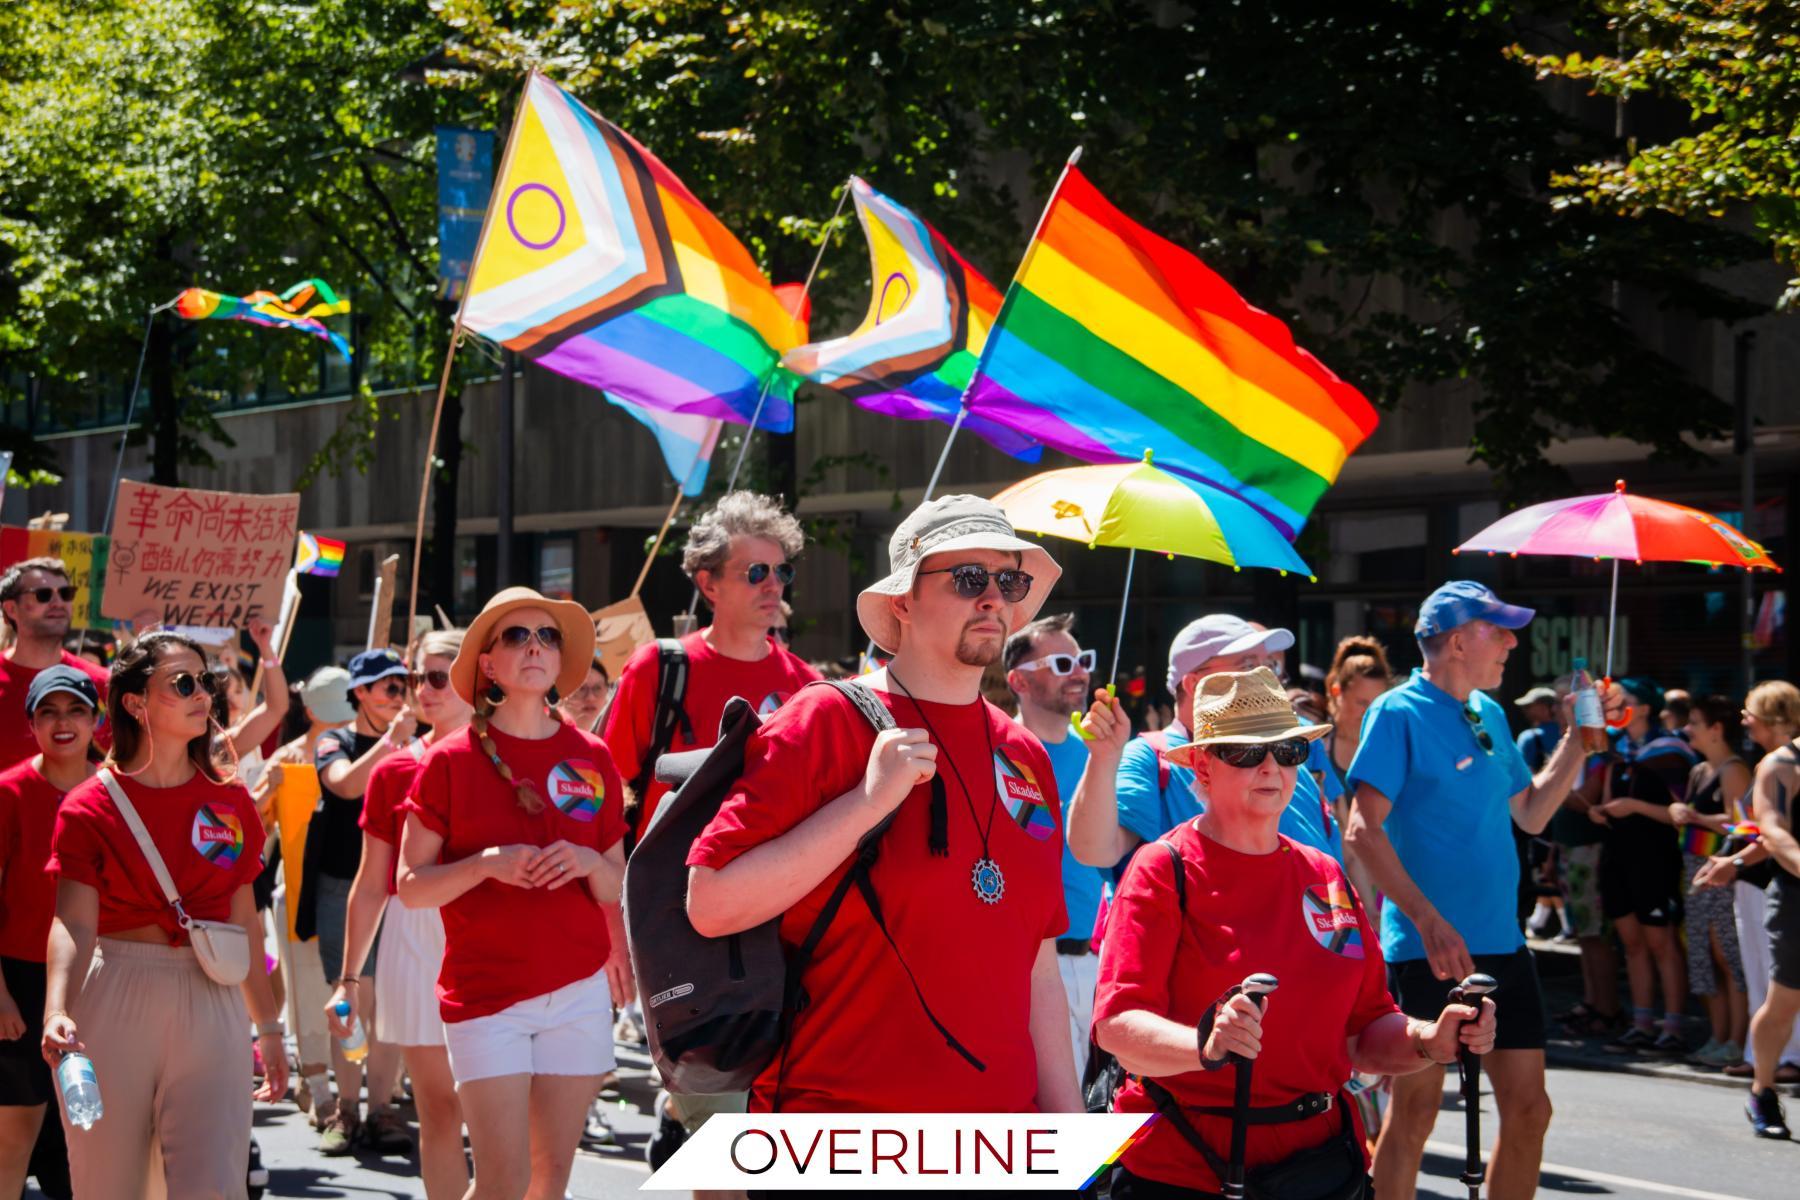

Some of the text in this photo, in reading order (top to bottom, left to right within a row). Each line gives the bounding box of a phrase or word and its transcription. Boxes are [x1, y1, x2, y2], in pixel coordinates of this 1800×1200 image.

[127, 487, 297, 543] 革命尚未结束
[140, 541, 285, 579] 酷儿仍需努力
[142, 576, 262, 602] WE EXIST
[1531, 616, 1630, 677] SCHAU
